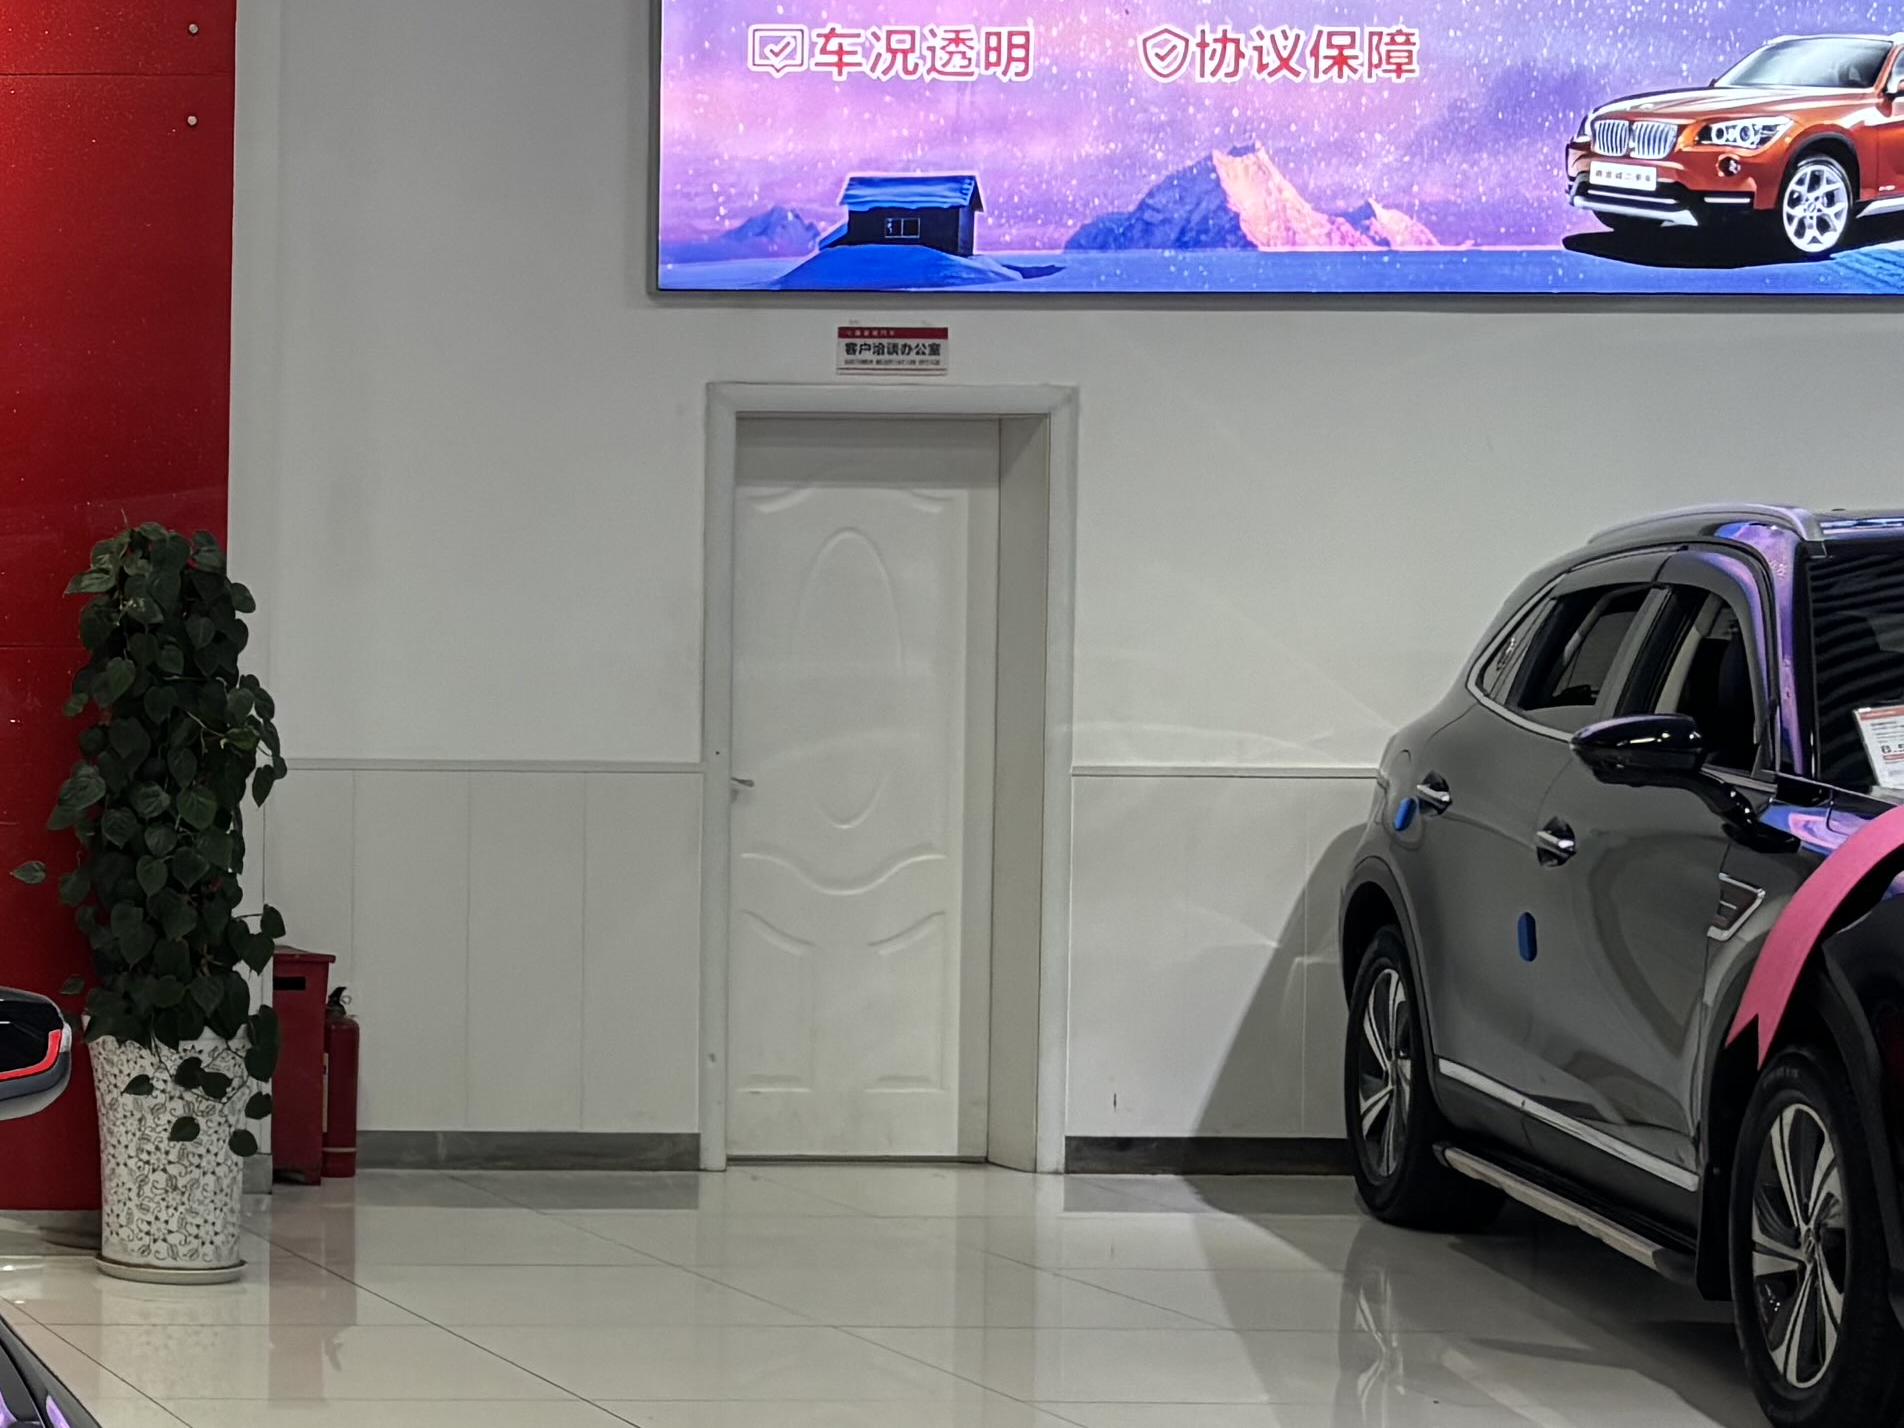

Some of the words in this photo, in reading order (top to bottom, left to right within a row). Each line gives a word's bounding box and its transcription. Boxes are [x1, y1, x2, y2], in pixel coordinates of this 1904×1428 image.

[813, 27, 1032, 80] 车况透明
[1195, 28, 1420, 81] 协议保障
